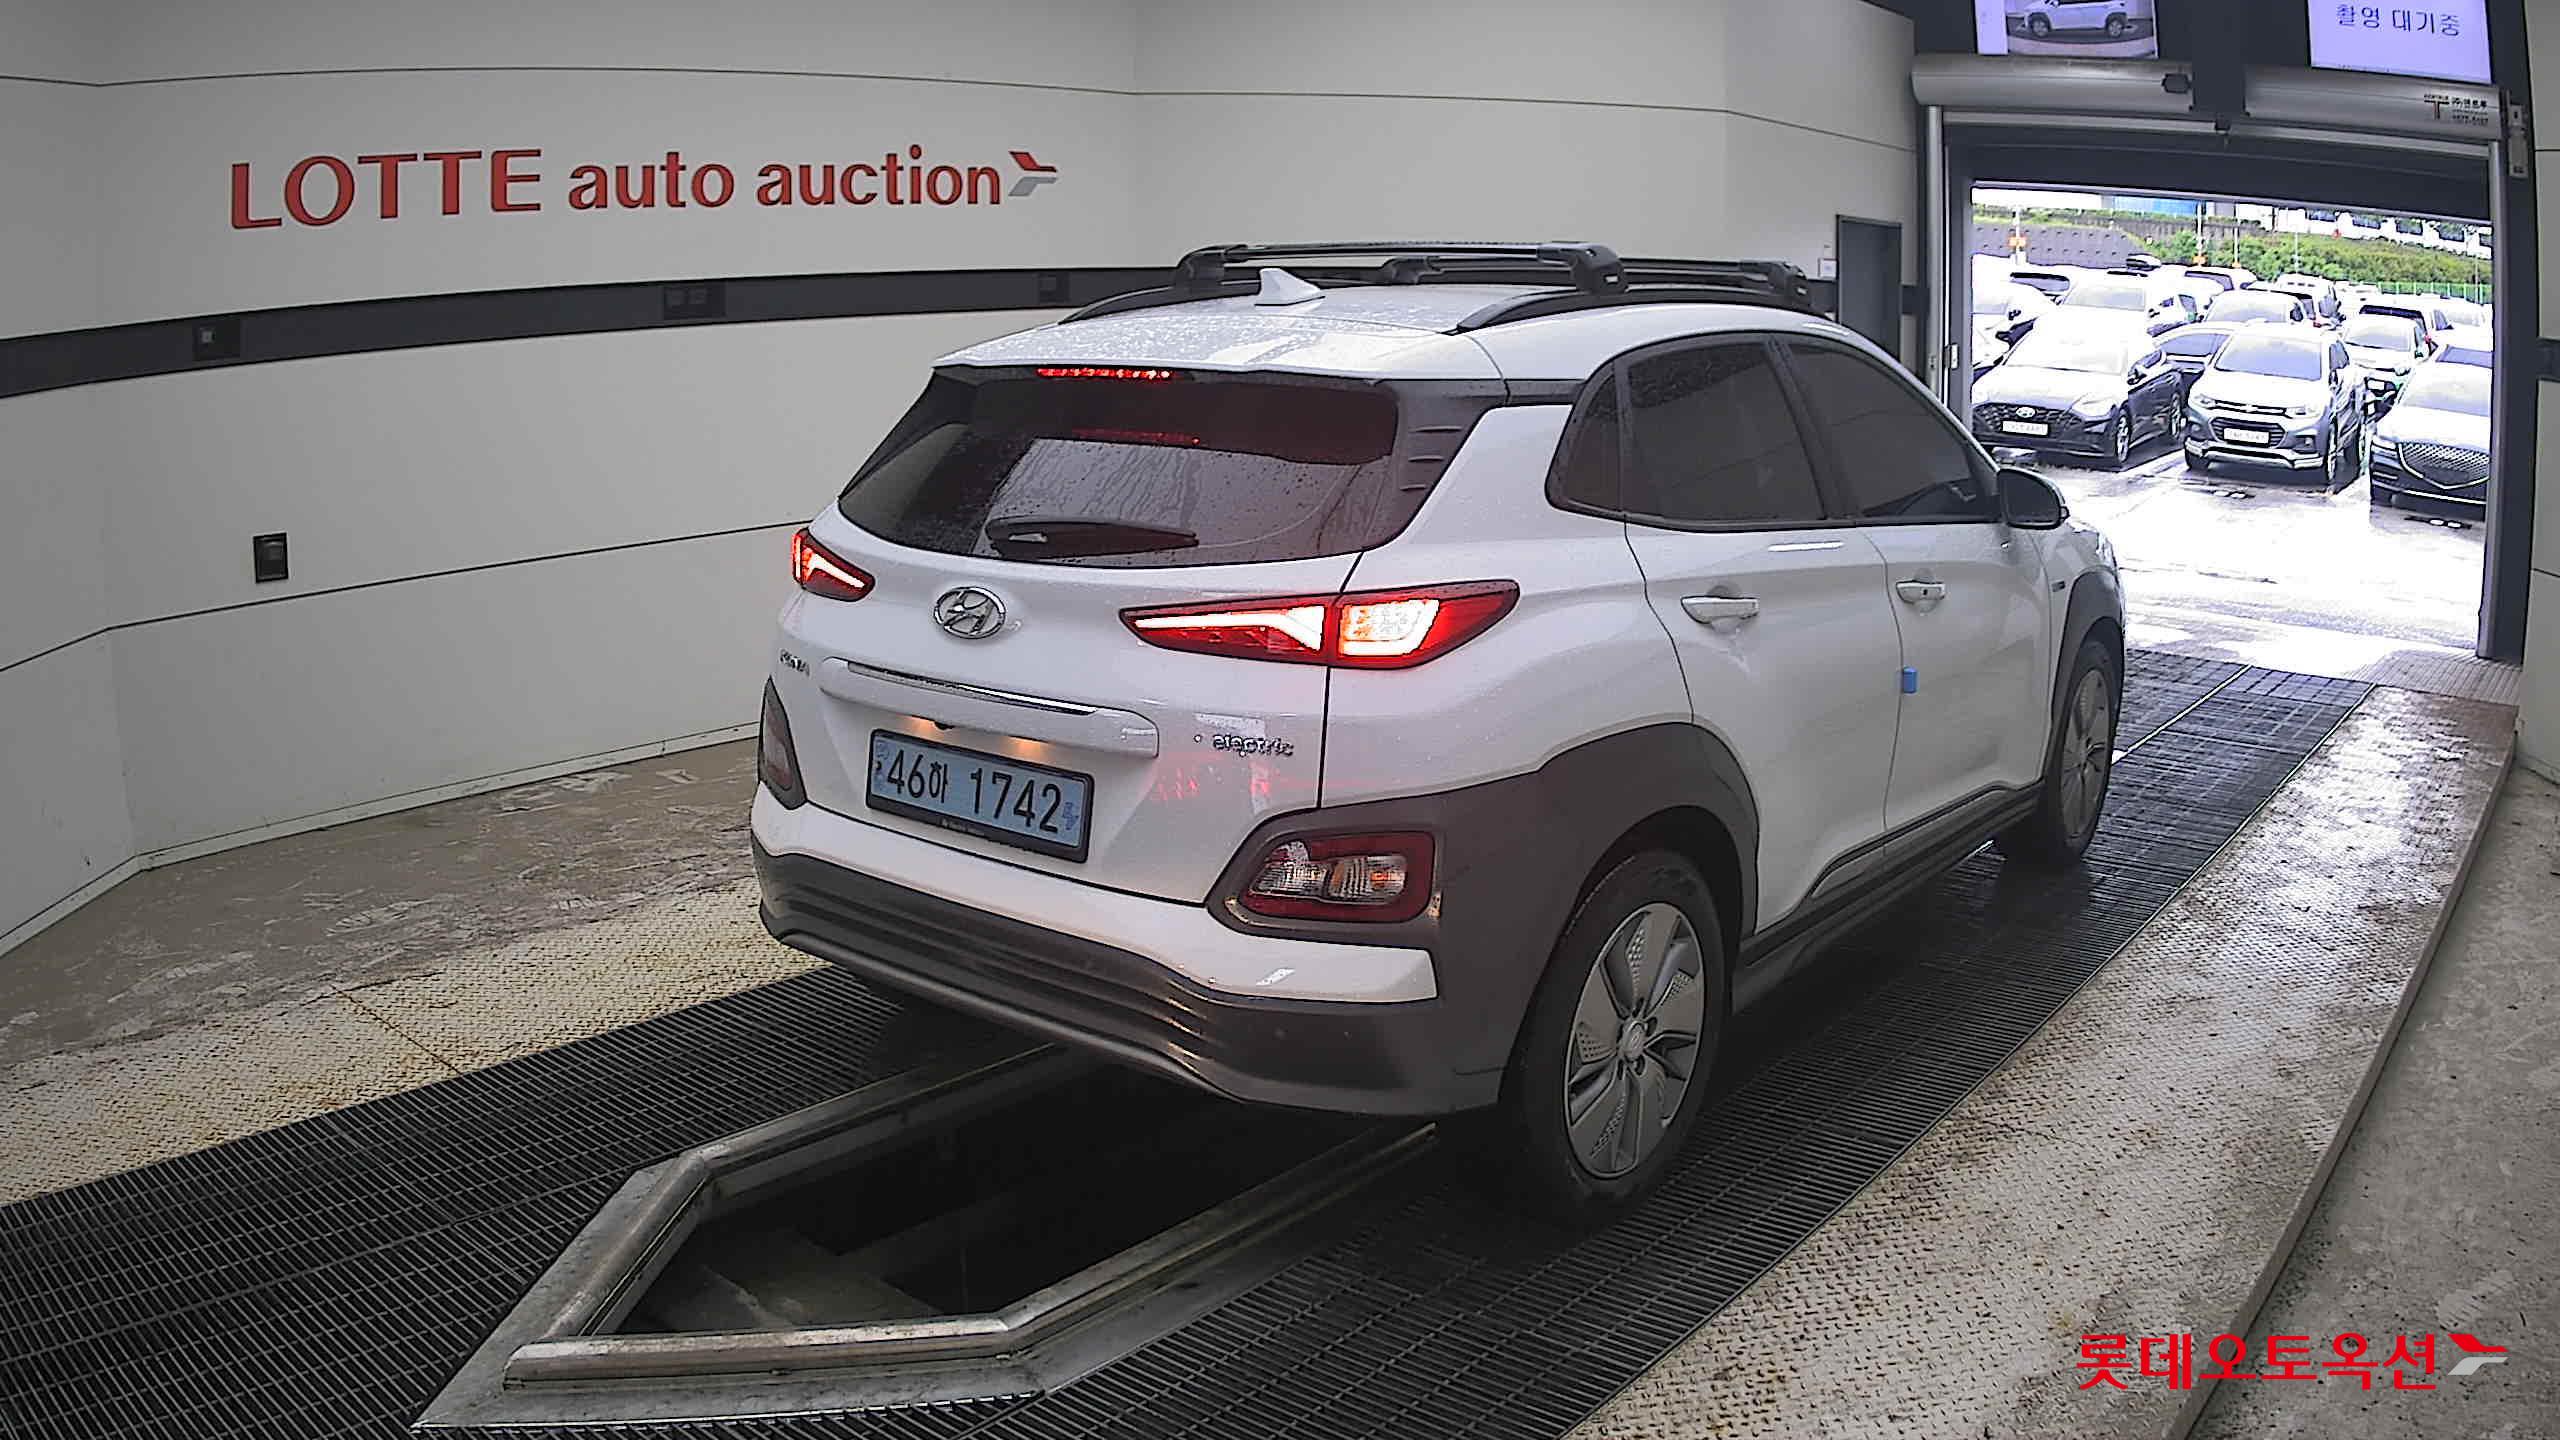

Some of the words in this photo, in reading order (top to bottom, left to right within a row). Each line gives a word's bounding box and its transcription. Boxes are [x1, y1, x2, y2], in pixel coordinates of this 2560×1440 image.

[2336, 4, 2380, 28] 촬영
[2391, 9, 2460, 36] 대기중
[230, 149, 542, 230] LOTTE
[568, 150, 735, 210] auto
[755, 144, 1002, 206] auction
[1212, 734, 1294, 757] electric
[887, 749, 949, 804] 46하
[970, 767, 1062, 833] 1742
